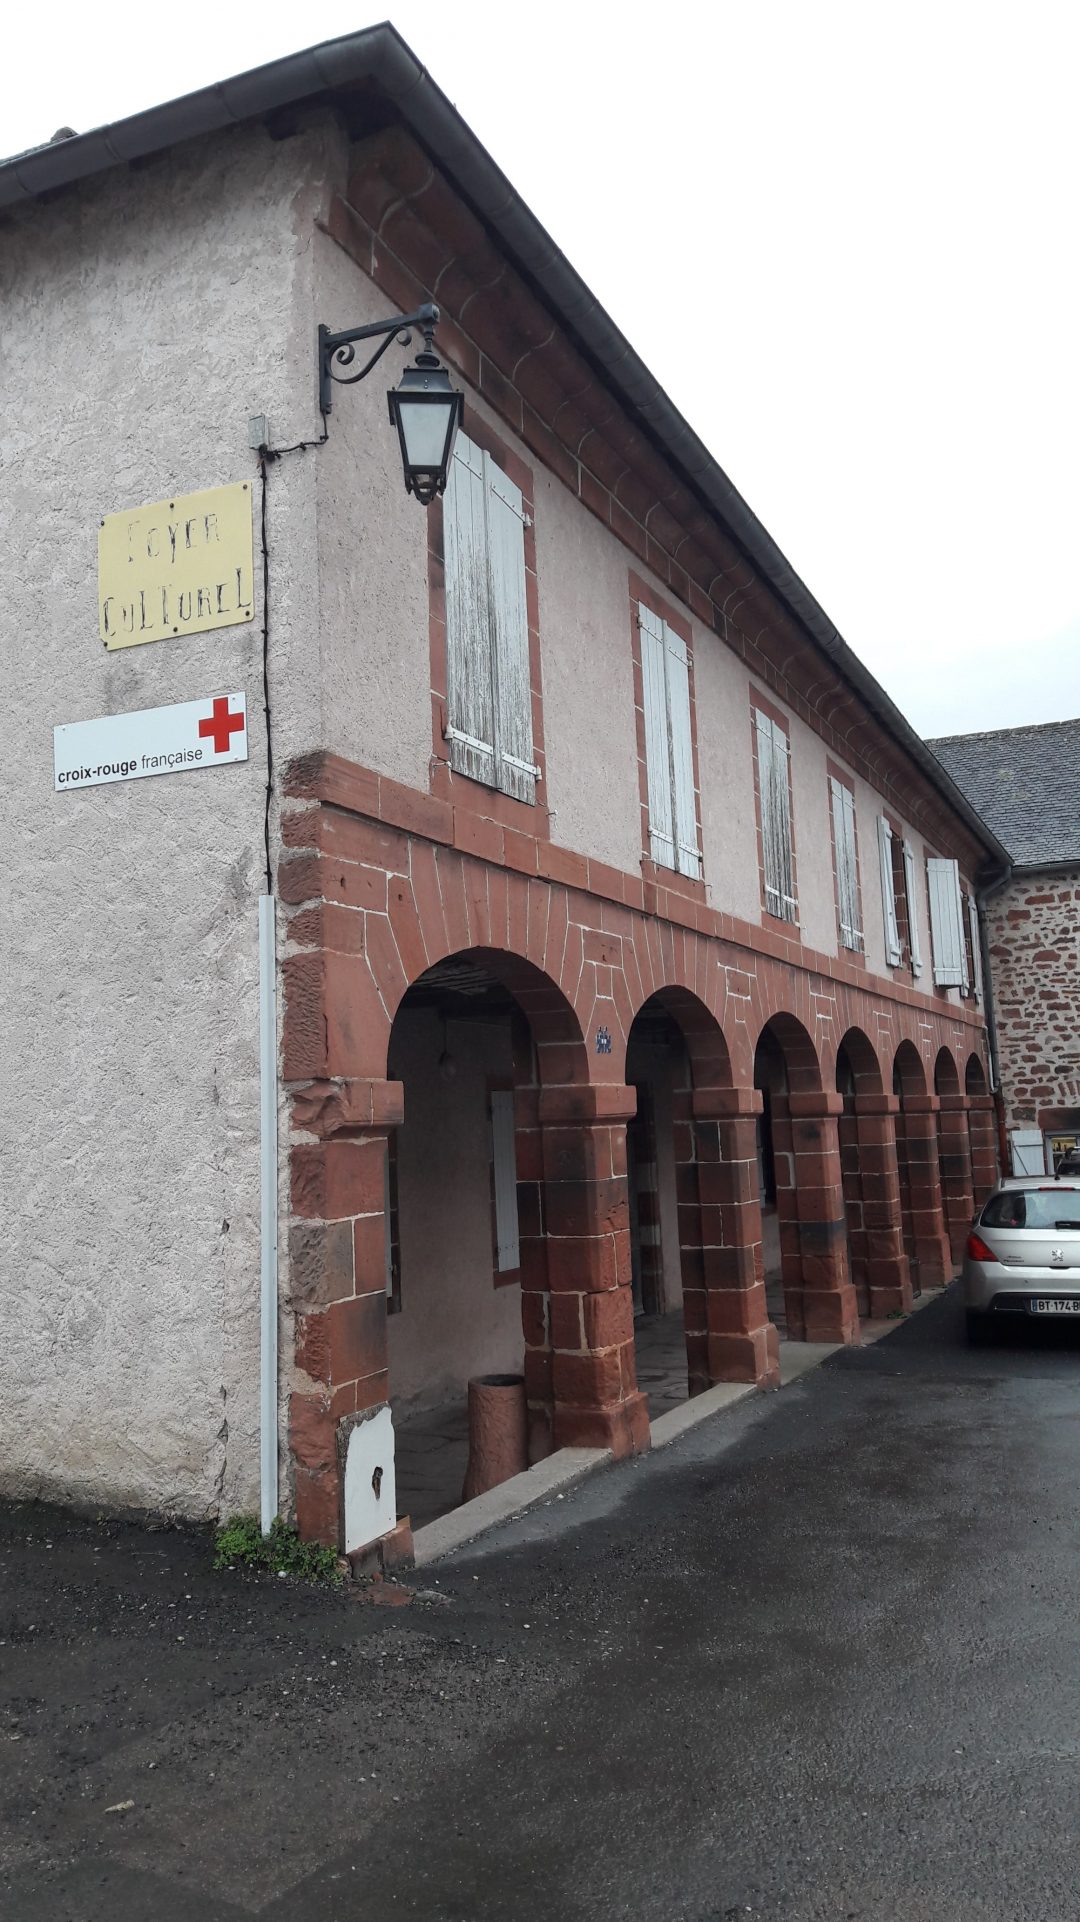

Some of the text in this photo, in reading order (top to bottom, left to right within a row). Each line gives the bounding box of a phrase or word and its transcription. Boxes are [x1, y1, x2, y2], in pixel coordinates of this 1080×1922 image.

[127, 513, 221, 563] FOYER
[103, 567, 252, 637] CULTUREL
[58, 748, 203, 783] croix-rouge française
[1038, 1300, 1080, 1311] BT-174-B
